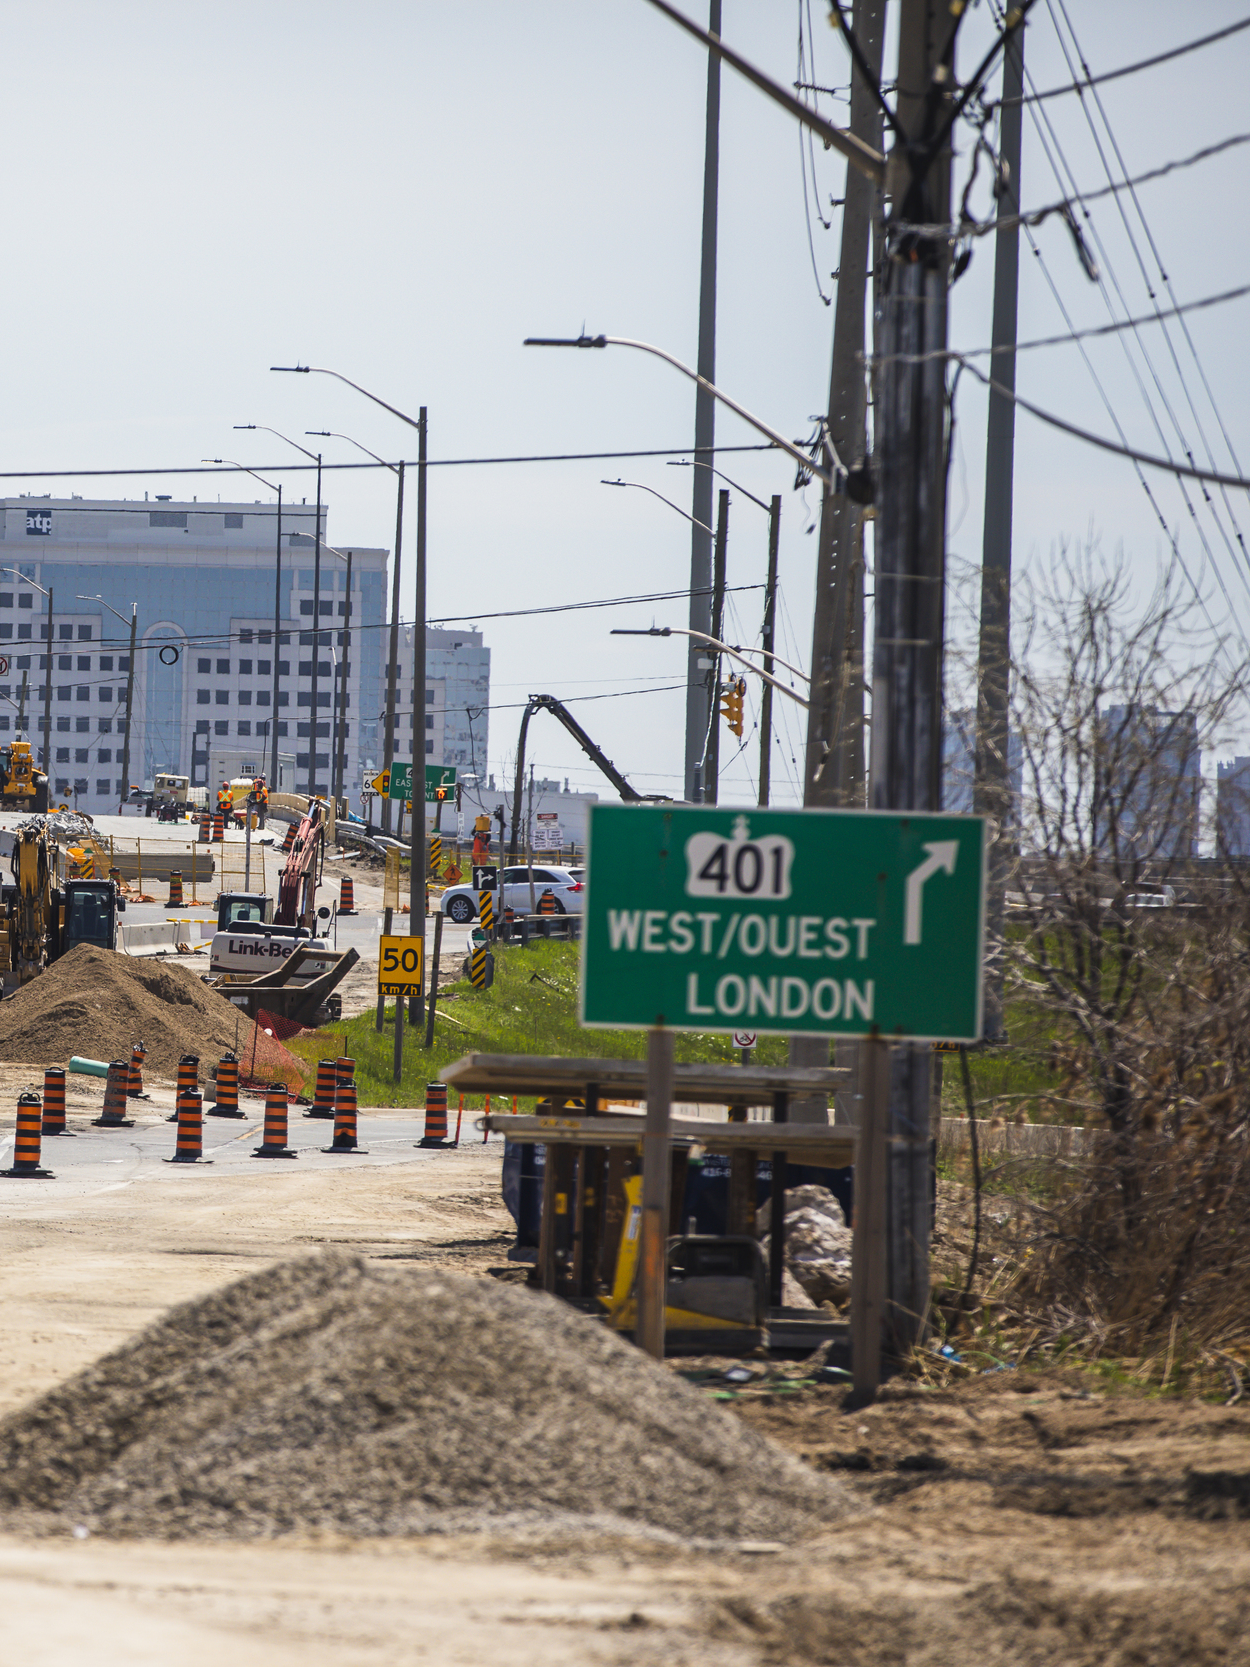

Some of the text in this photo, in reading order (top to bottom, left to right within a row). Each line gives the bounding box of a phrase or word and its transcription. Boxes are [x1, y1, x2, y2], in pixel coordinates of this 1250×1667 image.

[364, 780, 375, 788] 6
[396, 778, 433, 789] EASST
[699, 843, 783, 895] 401
[607, 908, 876, 960] WEST/OUEST
[228, 939, 299, 959] Link-Be
[383, 948, 418, 972] 50
[381, 984, 418, 996] km/h
[687, 972, 875, 1021] LONDON
